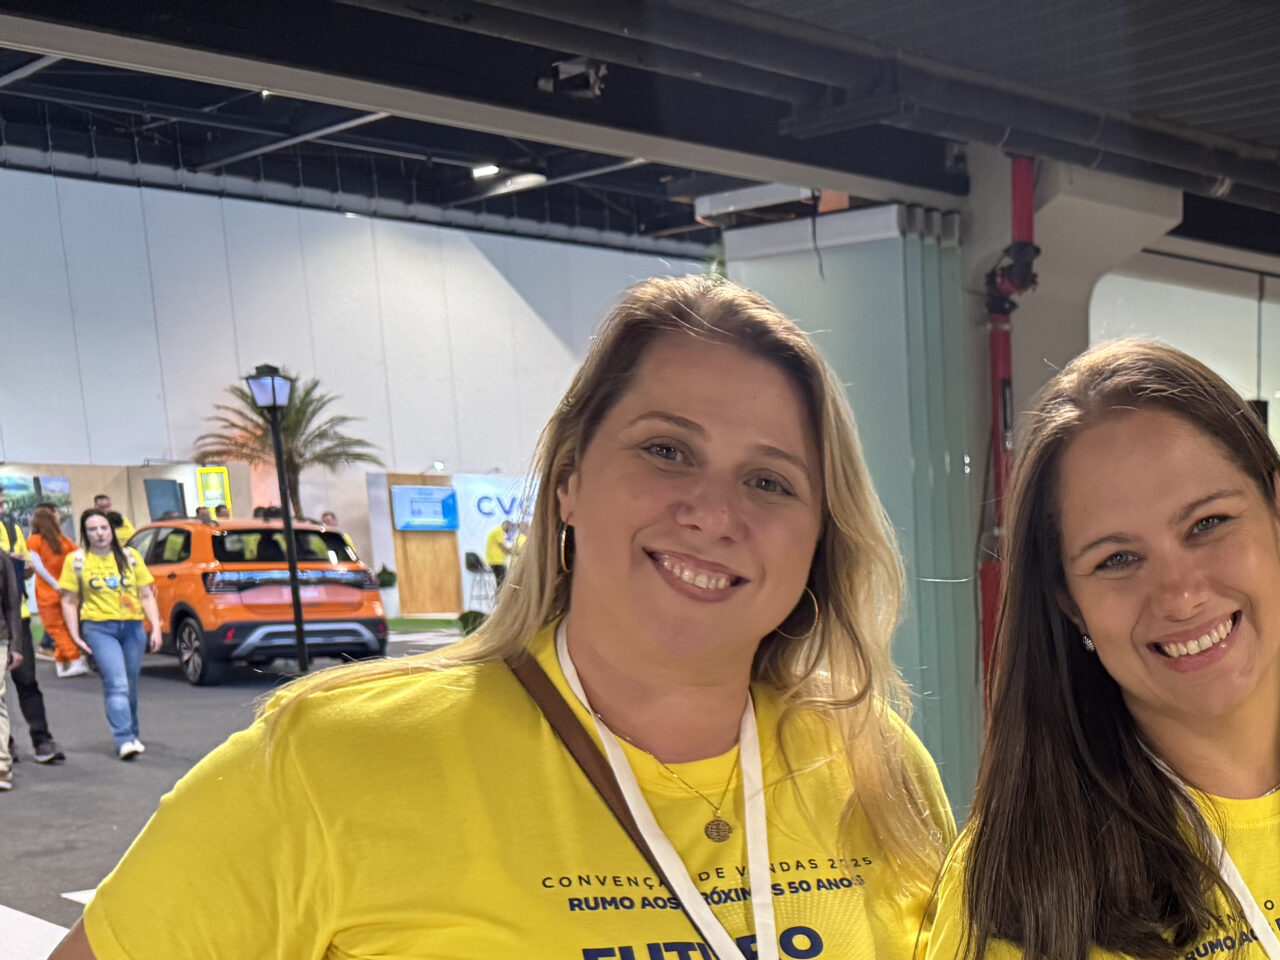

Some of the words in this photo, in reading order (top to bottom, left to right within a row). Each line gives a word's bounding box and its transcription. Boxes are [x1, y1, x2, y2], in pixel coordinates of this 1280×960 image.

[477, 495, 529, 517] CV
[541, 874, 669, 890] CONVENÇ
[697, 867, 726, 882] DE
[735, 858, 819, 878] VNDAS
[827, 856, 873, 870] 225
[568, 896, 635, 911] RUMO
[641, 896, 682, 910] AOS
[788, 879, 812, 894] 50
